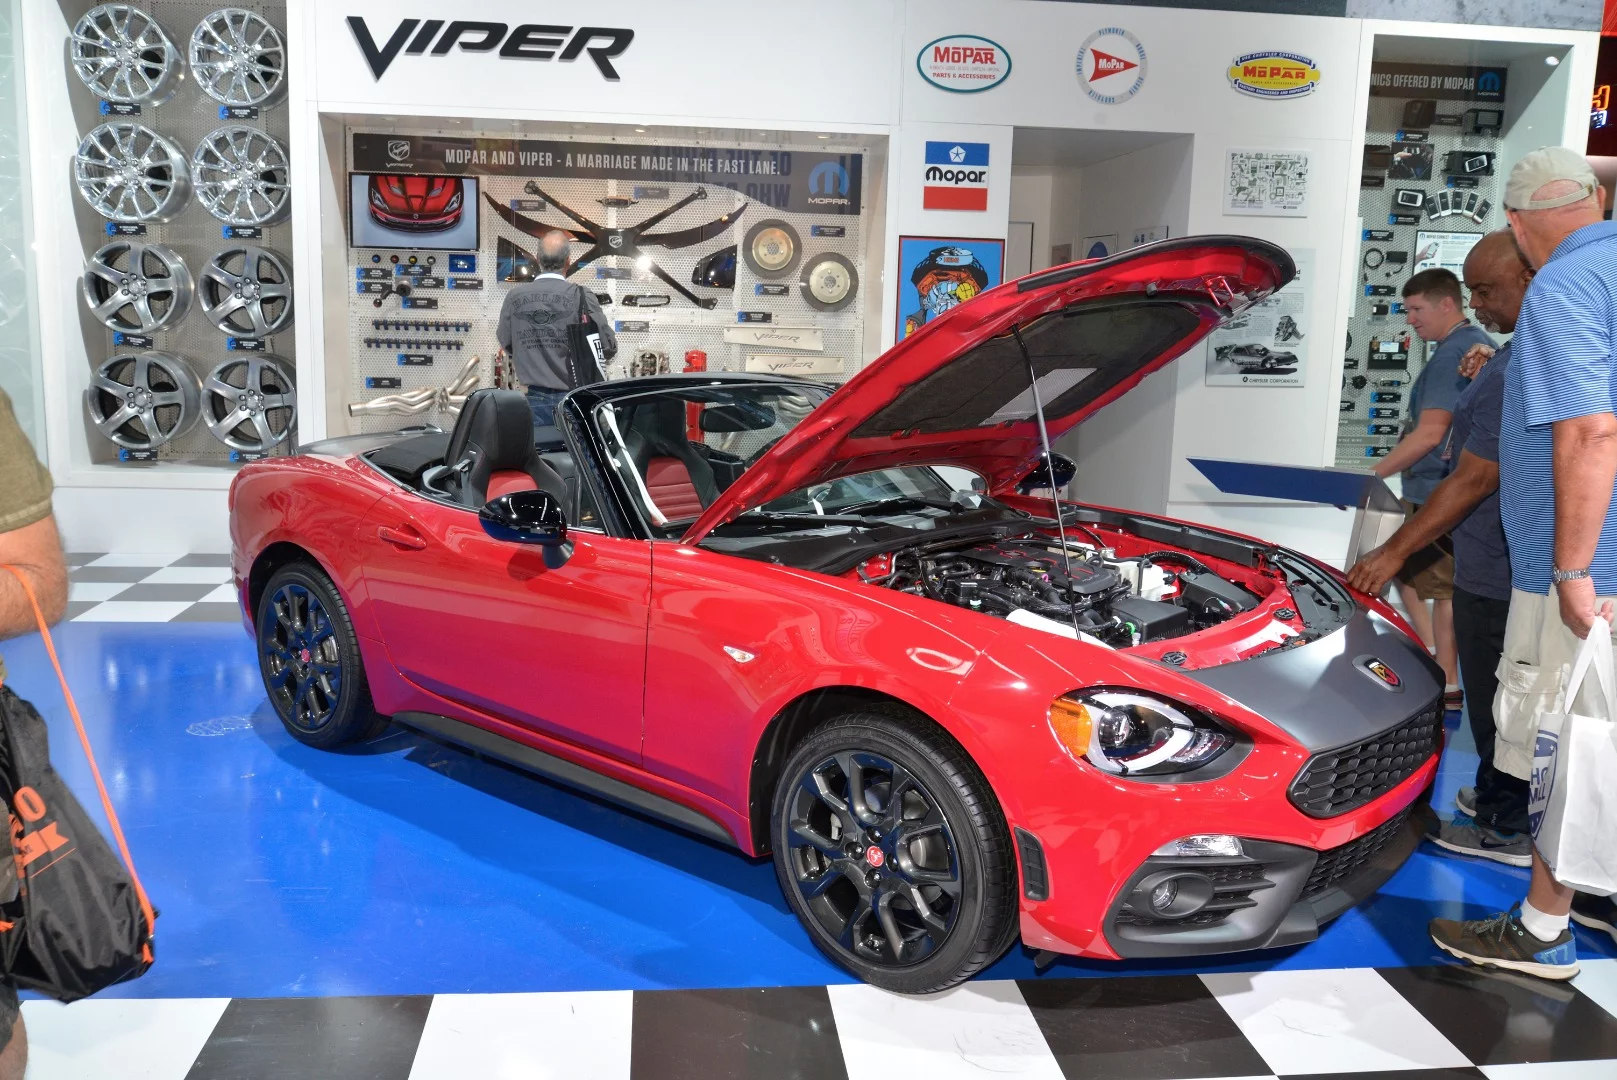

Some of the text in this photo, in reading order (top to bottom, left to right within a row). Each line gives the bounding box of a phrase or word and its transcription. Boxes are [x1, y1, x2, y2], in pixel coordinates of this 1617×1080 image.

[345, 16, 635, 82] VIPER
[1393, 74, 1428, 89] OFFERED
[1430, 76, 1442, 89] BY
[1443, 77, 1475, 91] MOPAR
[445, 149, 487, 165] MOPAR
[491, 150, 515, 166] AND
[519, 151, 553, 167] VIPER
[565, 152, 573, 168] A
[577, 153, 637, 170] MARRIAGE
[641, 156, 673, 171] MADE
[676, 157, 689, 172] IN
[692, 158, 714, 174] THE
[717, 159, 747, 175] FAST
[749, 159, 781, 176] LANE.
[754, 332, 801, 344] VIPER
[768, 361, 815, 372] VIPER
